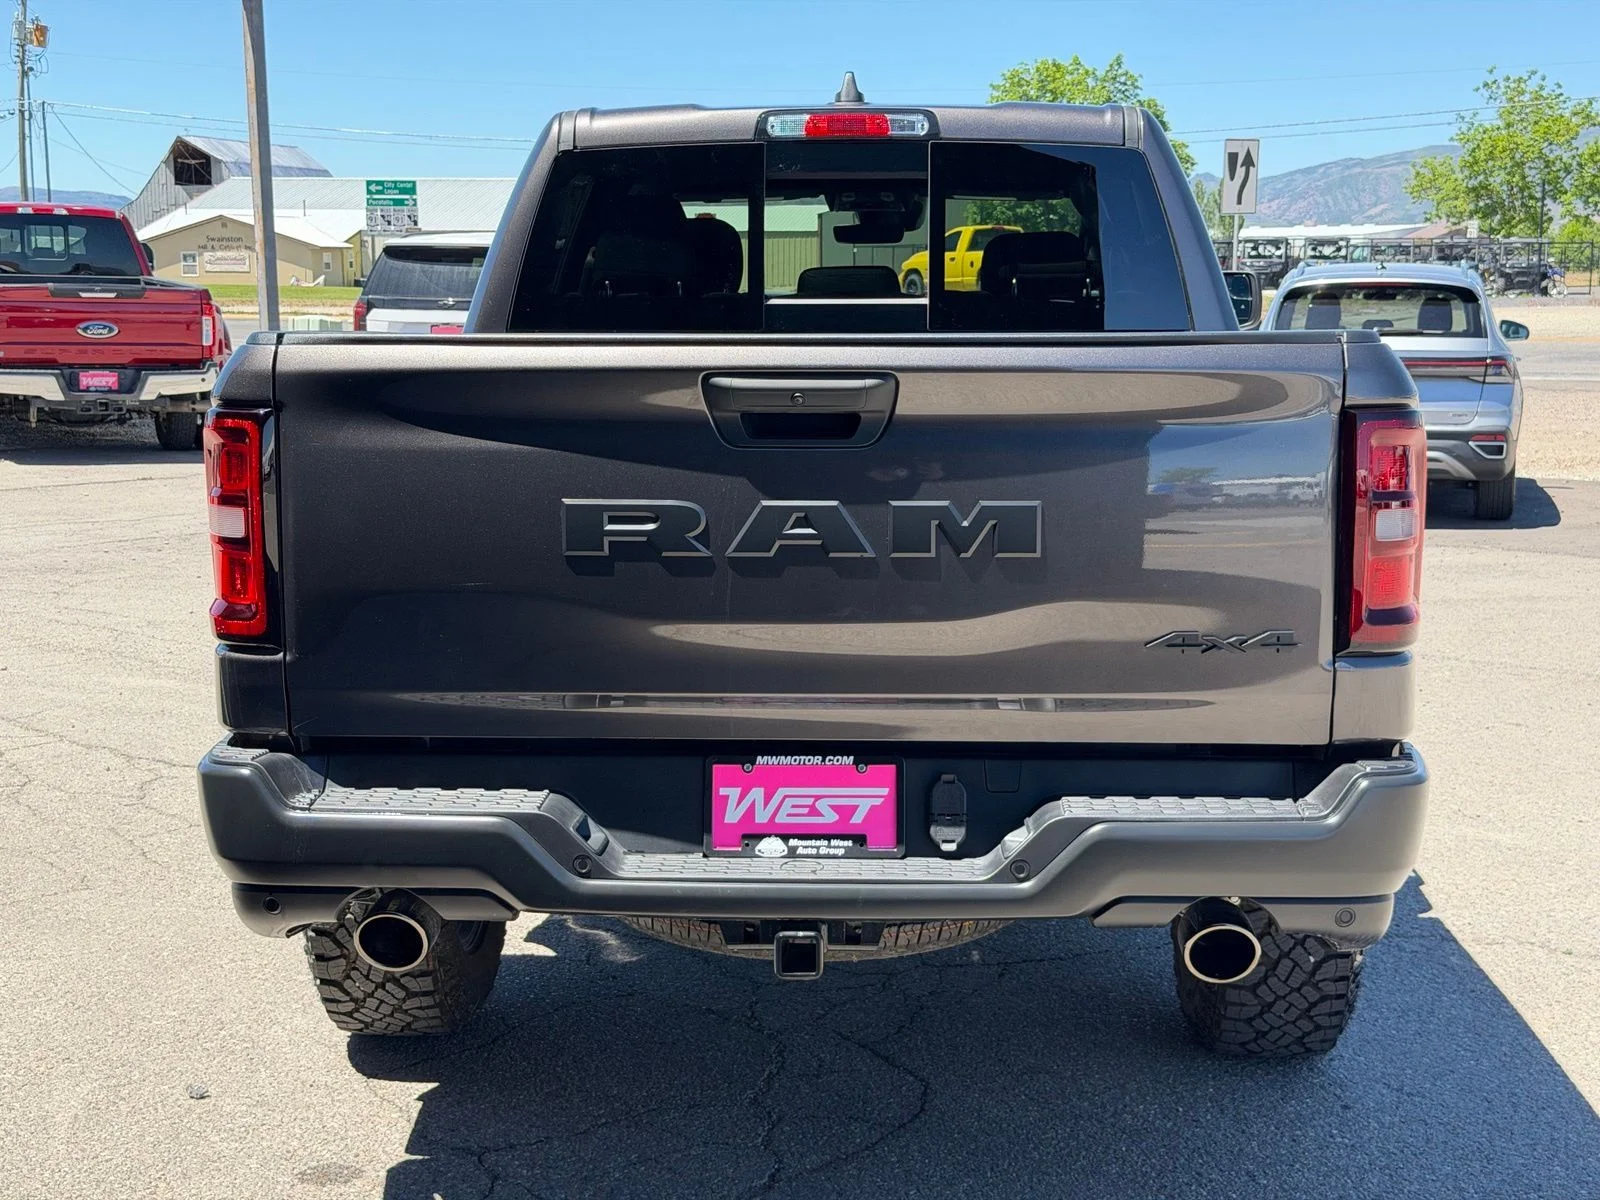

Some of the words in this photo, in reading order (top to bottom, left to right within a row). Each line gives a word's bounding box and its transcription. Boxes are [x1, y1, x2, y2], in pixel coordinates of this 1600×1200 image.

[206, 234, 243, 243] Swainston
[87, 325, 109, 335] Ford
[81, 377, 116, 386] WEST
[561, 498, 1042, 558] RAM
[755, 755, 854, 766] MWMOTOR.COM
[719, 787, 890, 824] WEST
[788, 838, 829, 847] Mountain
[830, 839, 853, 847] West
[796, 846, 818, 855] Auto
[818, 846, 846, 857] Group
